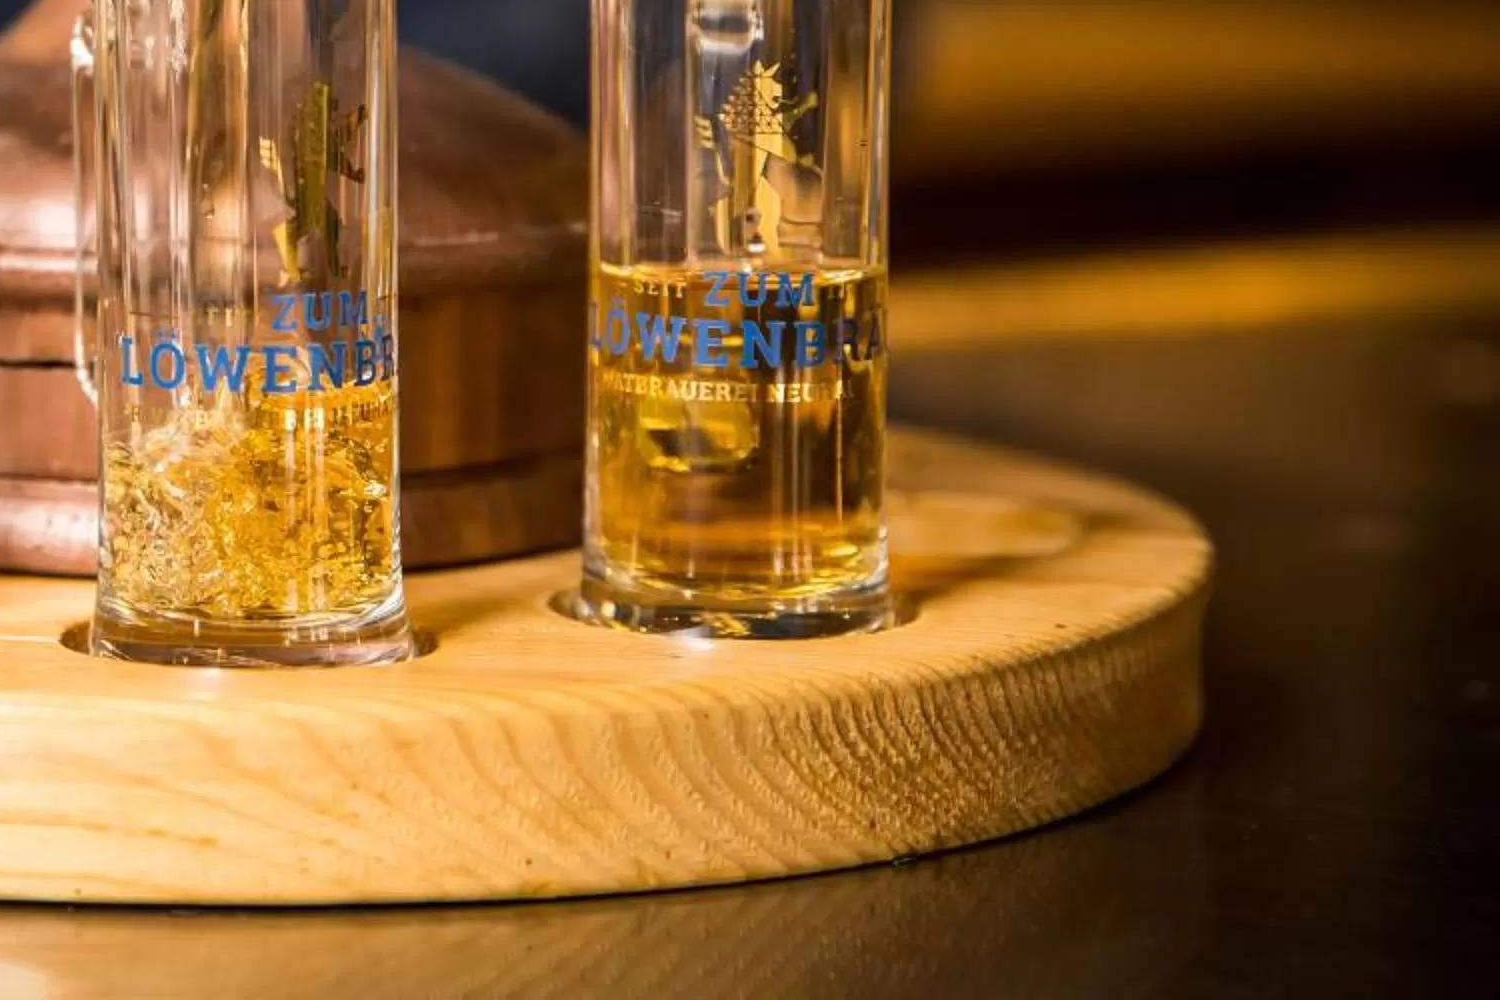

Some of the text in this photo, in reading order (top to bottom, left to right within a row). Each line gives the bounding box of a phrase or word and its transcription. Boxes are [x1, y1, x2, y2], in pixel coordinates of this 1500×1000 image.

[633, 280, 687, 298] SEIT
[703, 271, 814, 308] ZUM
[271, 290, 367, 331] ZUM
